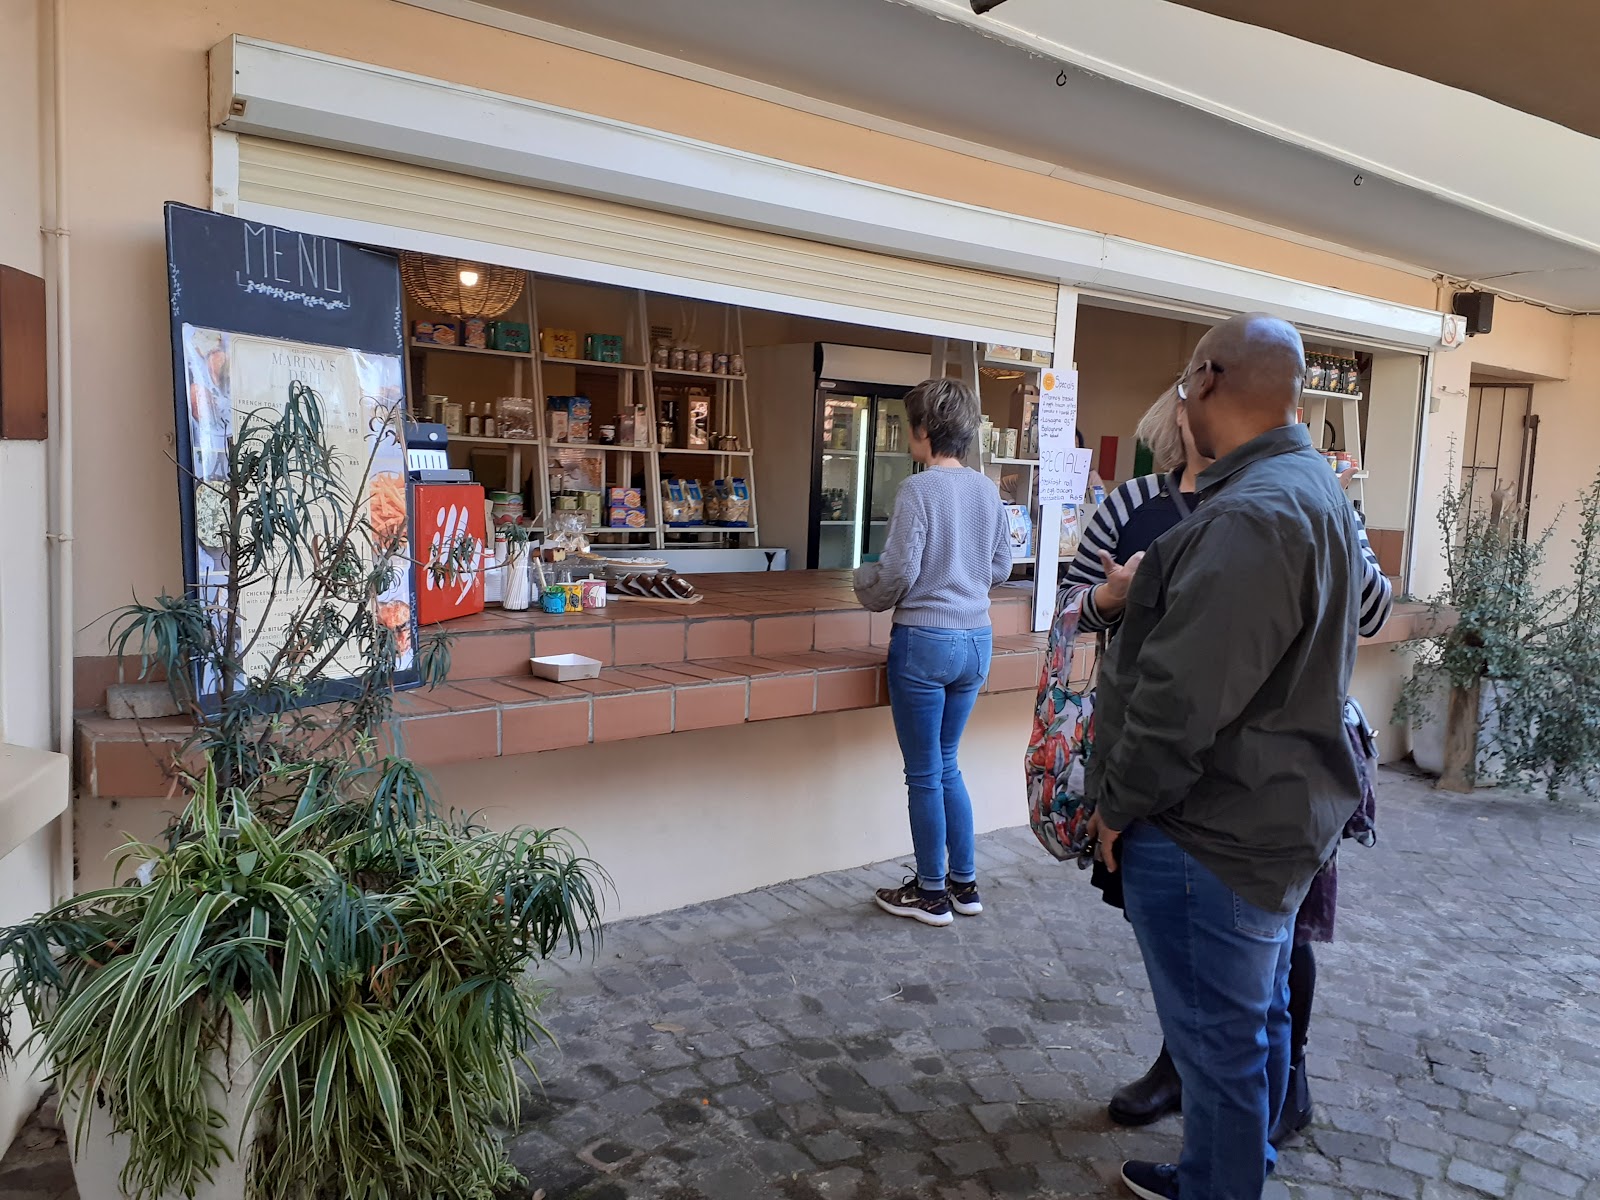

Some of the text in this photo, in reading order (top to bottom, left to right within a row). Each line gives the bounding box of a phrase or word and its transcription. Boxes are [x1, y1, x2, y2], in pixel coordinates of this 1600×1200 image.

[244, 222, 342, 293] MENU
[272, 352, 337, 373] MARINA'S
[288, 368, 321, 385] DELI
[264, 401, 282, 409] TOAST
[426, 504, 485, 610] illy
